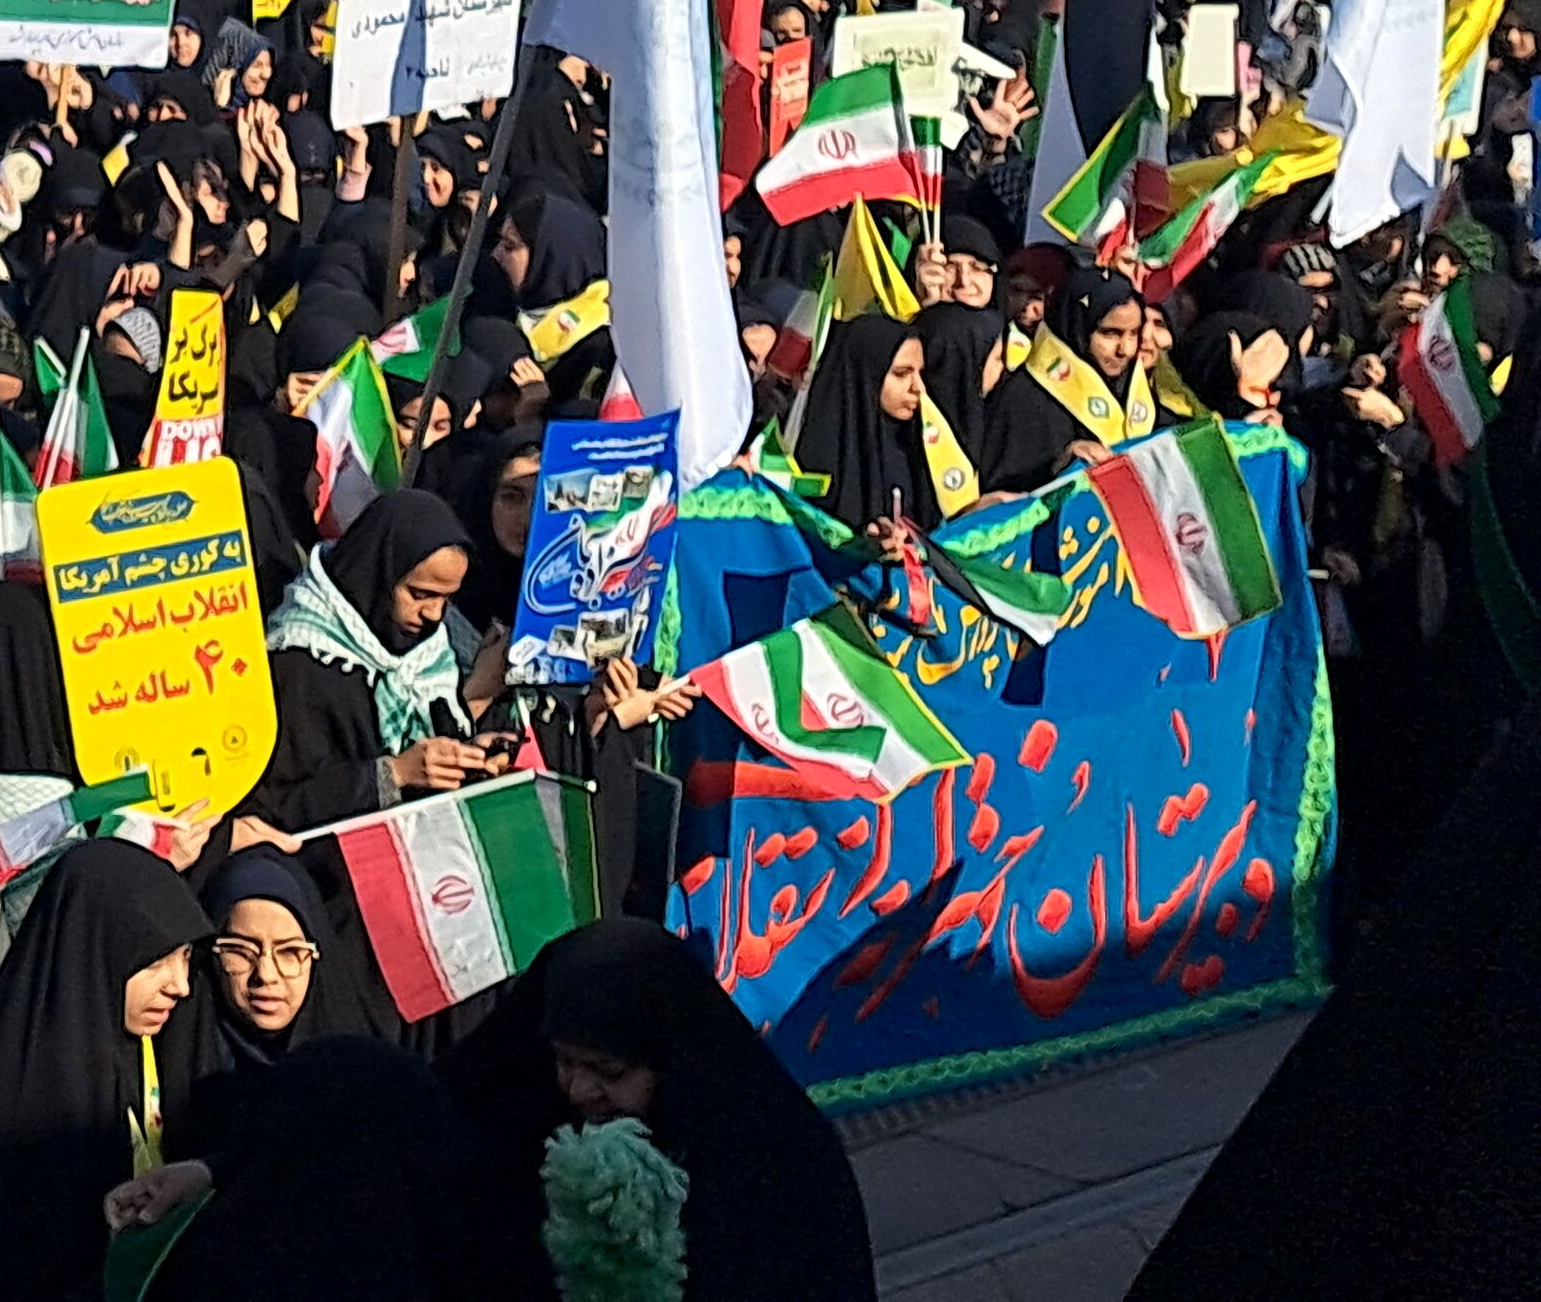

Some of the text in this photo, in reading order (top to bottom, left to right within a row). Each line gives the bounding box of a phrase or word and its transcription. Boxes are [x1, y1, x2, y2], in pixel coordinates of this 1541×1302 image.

[57, 538, 242, 595] به کوری چشم آمریکا
[72, 580, 249, 654] انقلاب اسلامی
[87, 679, 128, 717] شد
[134, 666, 191, 702] ساله
